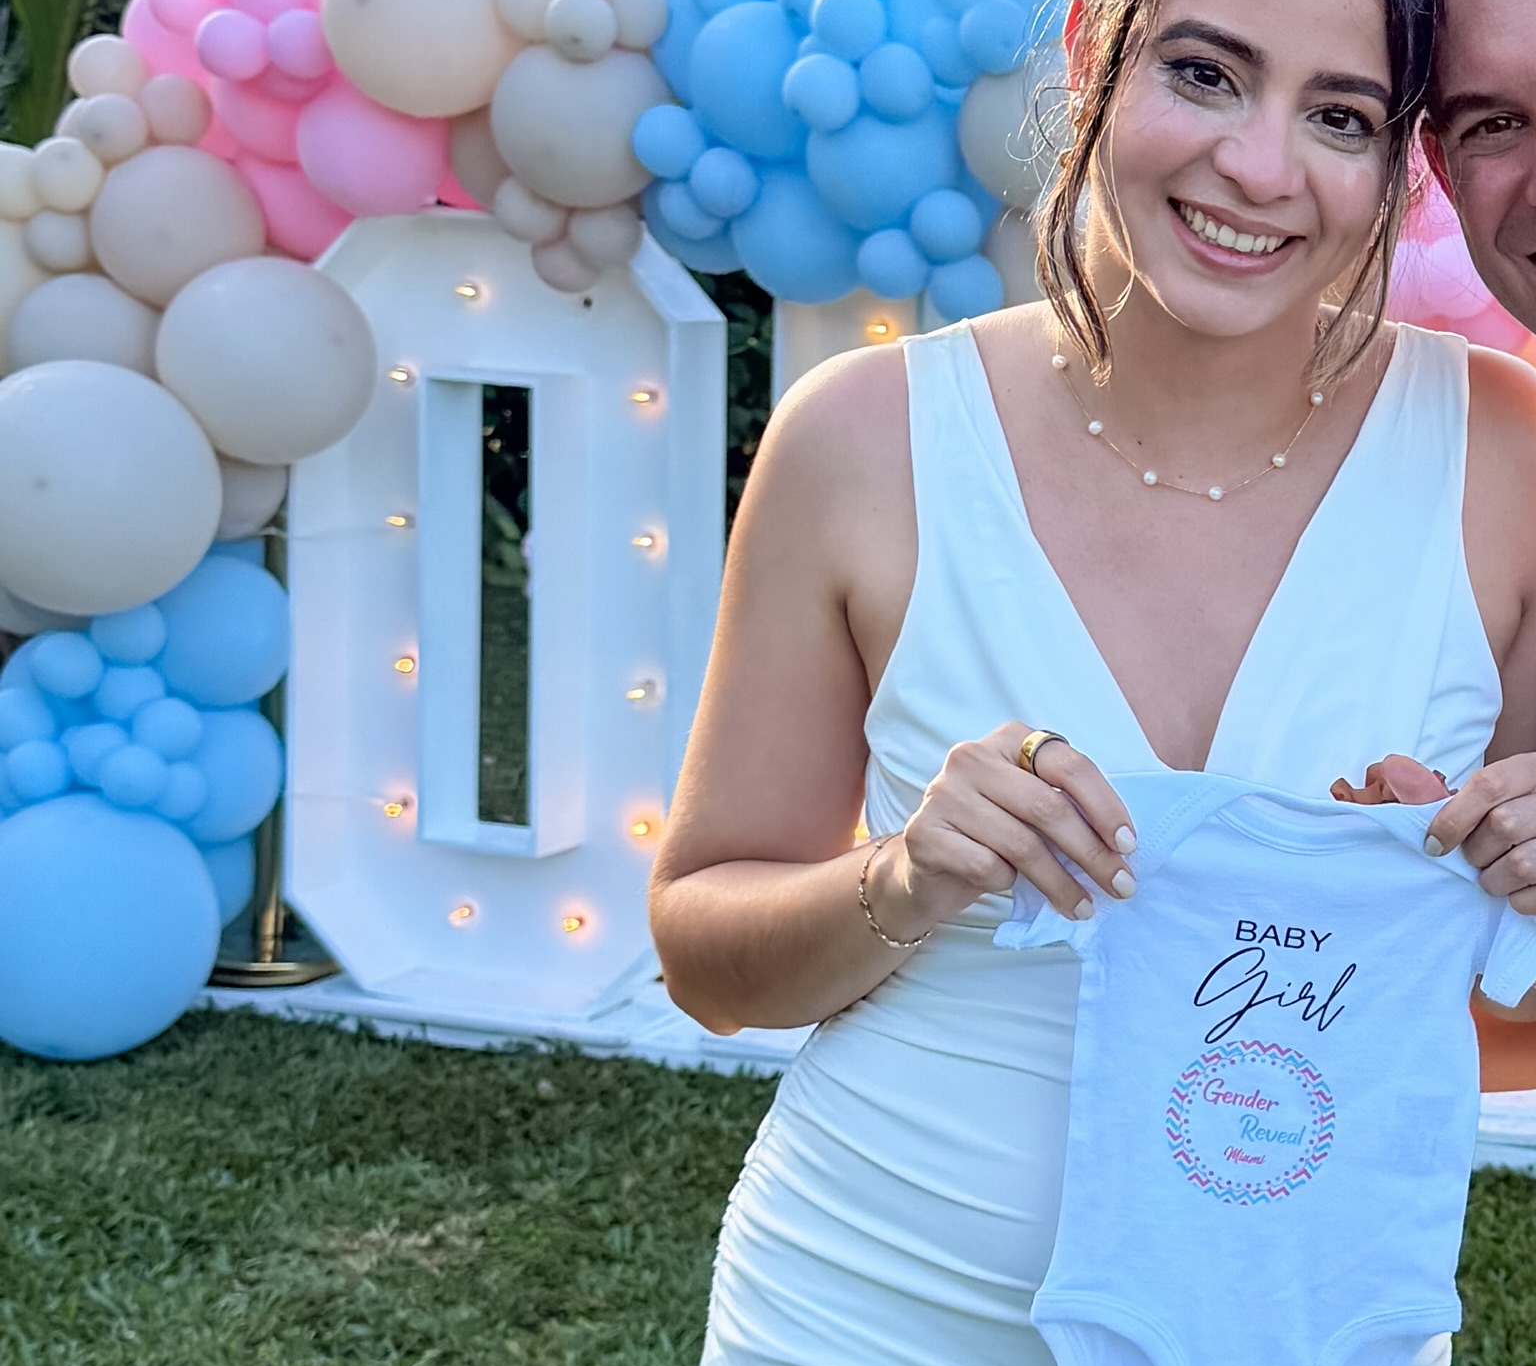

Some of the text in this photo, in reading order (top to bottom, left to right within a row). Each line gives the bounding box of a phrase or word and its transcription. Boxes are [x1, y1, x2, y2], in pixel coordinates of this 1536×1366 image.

[1235, 919, 1333, 952] BABY
[1193, 946, 1357, 1044] Girl
[1203, 1077, 1280, 1112] Gender
[1239, 1113, 1307, 1146] Reveal
[1223, 1145, 1266, 1165] Miami
